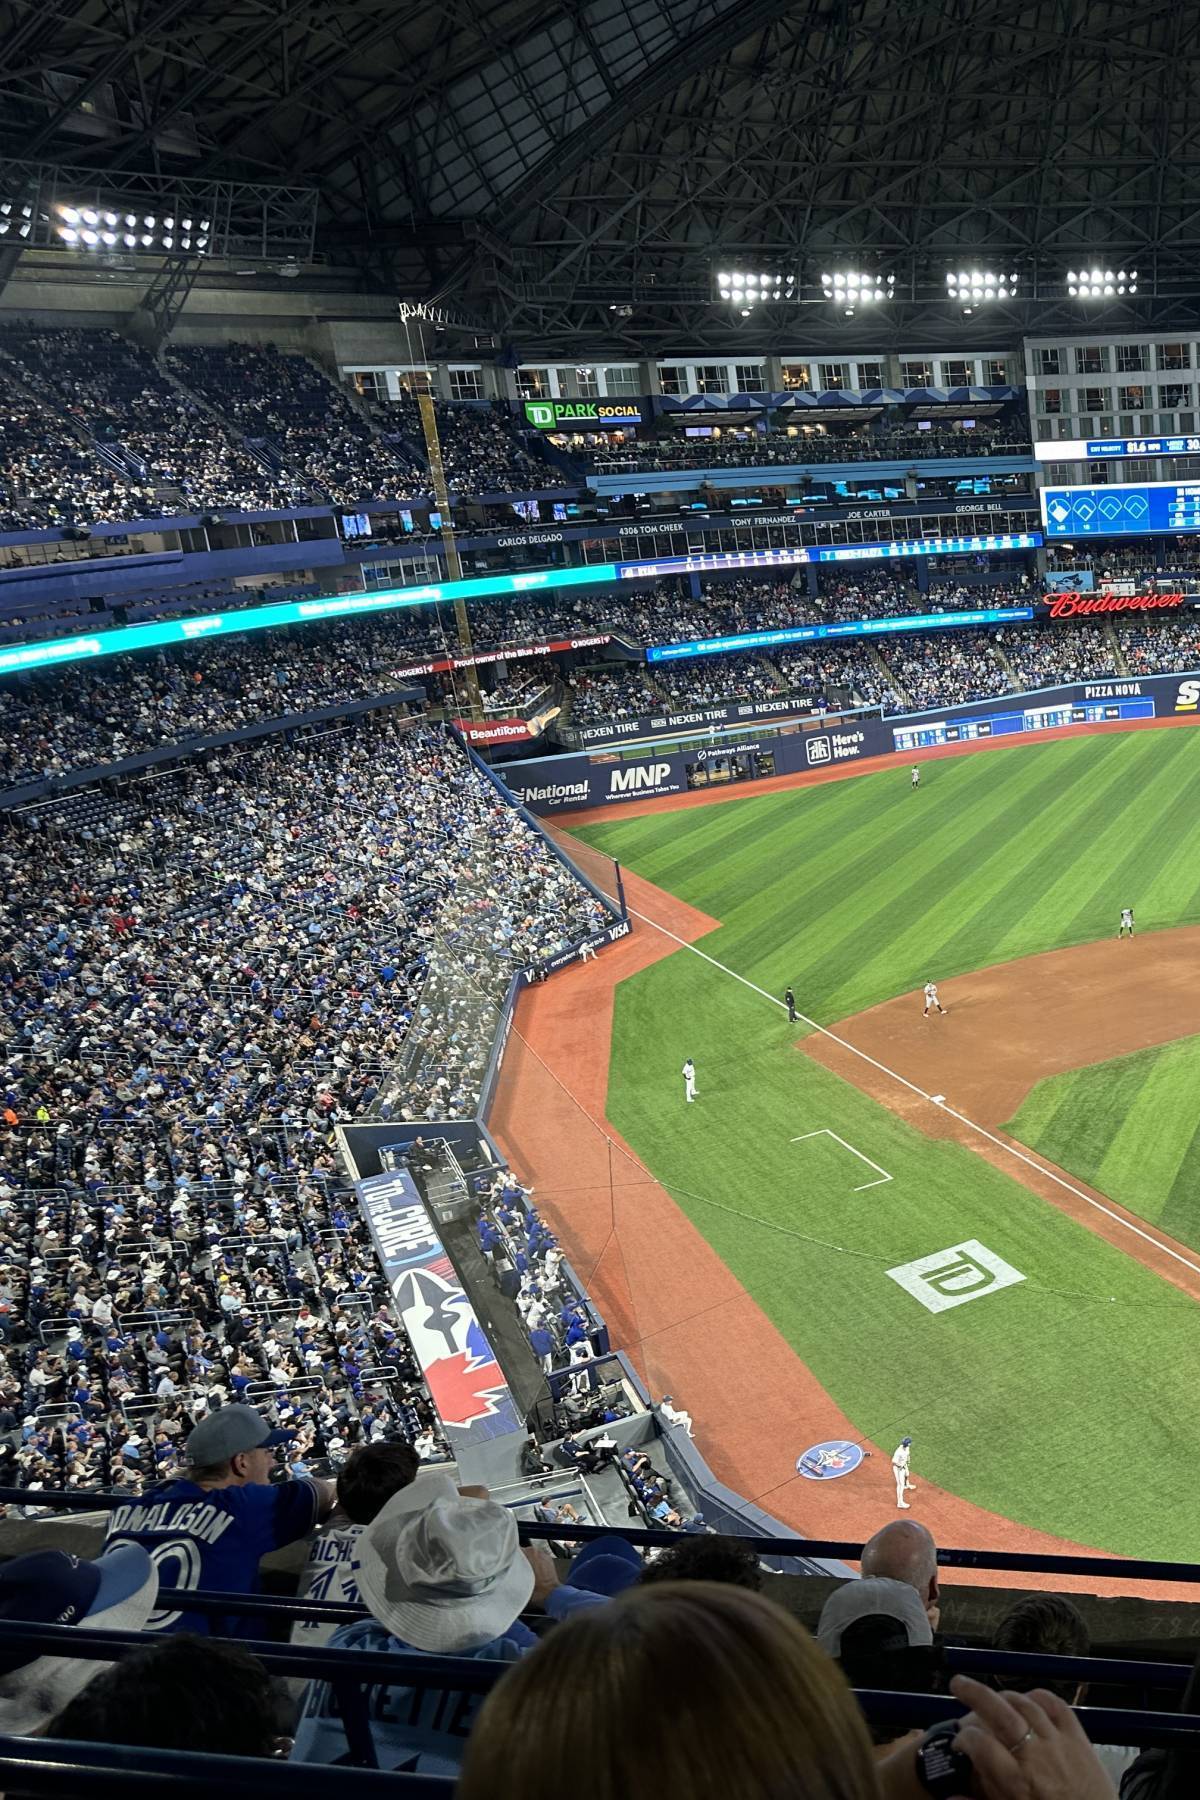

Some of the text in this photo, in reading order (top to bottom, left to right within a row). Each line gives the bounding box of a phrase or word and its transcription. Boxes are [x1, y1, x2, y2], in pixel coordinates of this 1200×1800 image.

[528, 404, 641, 424] TD PARK SOCIAL
[1126, 442, 1146, 452] 81.6
[847, 510, 891, 519] JOE CARTER
[956, 504, 984, 513] GEORGE
[730, 516, 796, 526] TONY FERNANDEZ
[619, 523, 684, 536] 4306 TOM CHEEK
[497, 533, 562, 548] CARLOS DELGADO
[1043, 590, 1184, 618] Budweiser
[398, 637, 601, 678] ROGERS Proud owner of the Blue Jays ROGERS
[1085, 682, 1142, 698] PIZZA NOVA
[580, 698, 814, 740] NEXEN TIRE NEXEN TIRE NEXEN TIRE
[832, 732, 865, 746] Here's
[708, 743, 760, 758] Pathways Alliance
[833, 745, 860, 759] How.
[610, 762, 672, 792] MNP
[563, 794, 588, 803] Rental
[606, 791, 632, 801] Wherever
[633, 788, 654, 798] Business
[654, 786, 670, 794] Takes
[362, 1178, 440, 1258] TO THE CORE
[921, 1250, 996, 1298] TD
[104, 1538, 201, 1631] 0
